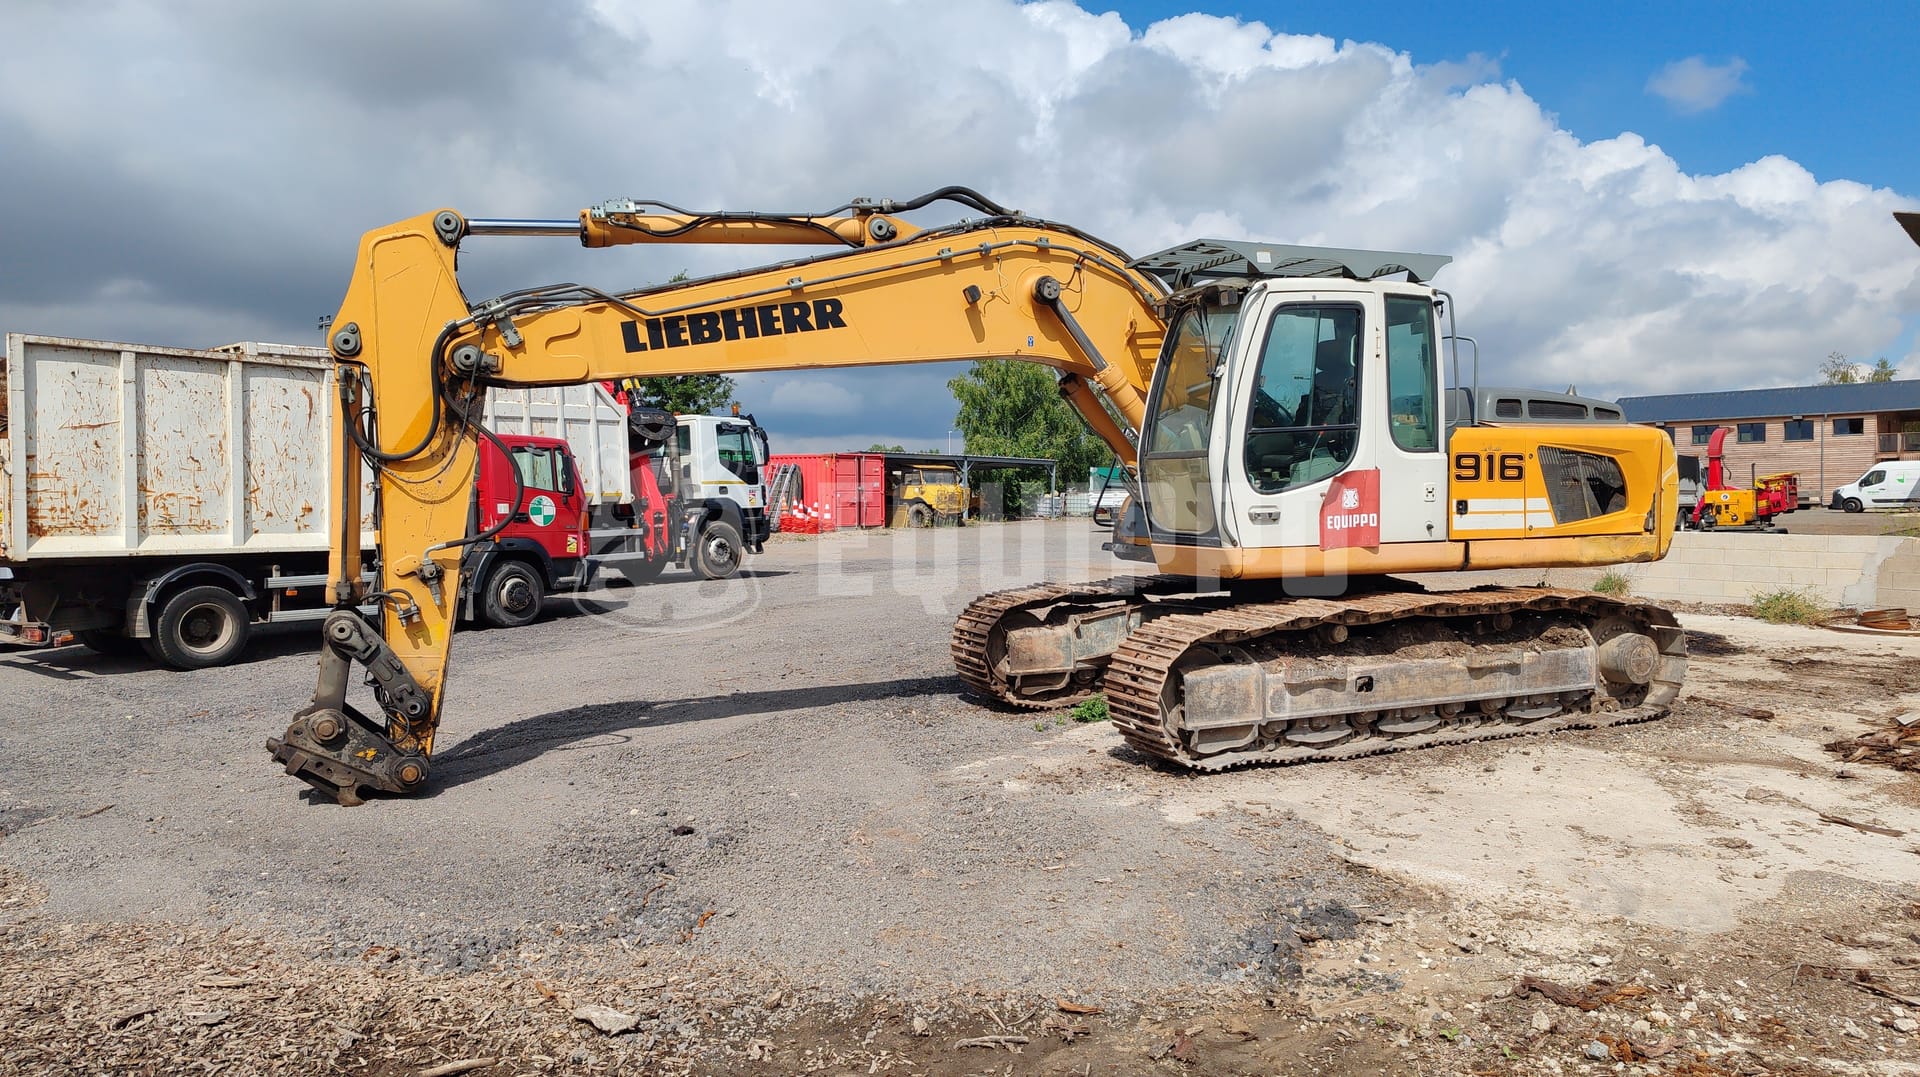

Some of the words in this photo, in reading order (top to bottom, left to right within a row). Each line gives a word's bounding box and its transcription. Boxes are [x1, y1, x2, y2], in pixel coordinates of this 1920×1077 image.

[621, 298, 847, 353] LIEBHERR
[1455, 453, 1524, 481] 916
[1327, 513, 1377, 530] EQUIPPO
